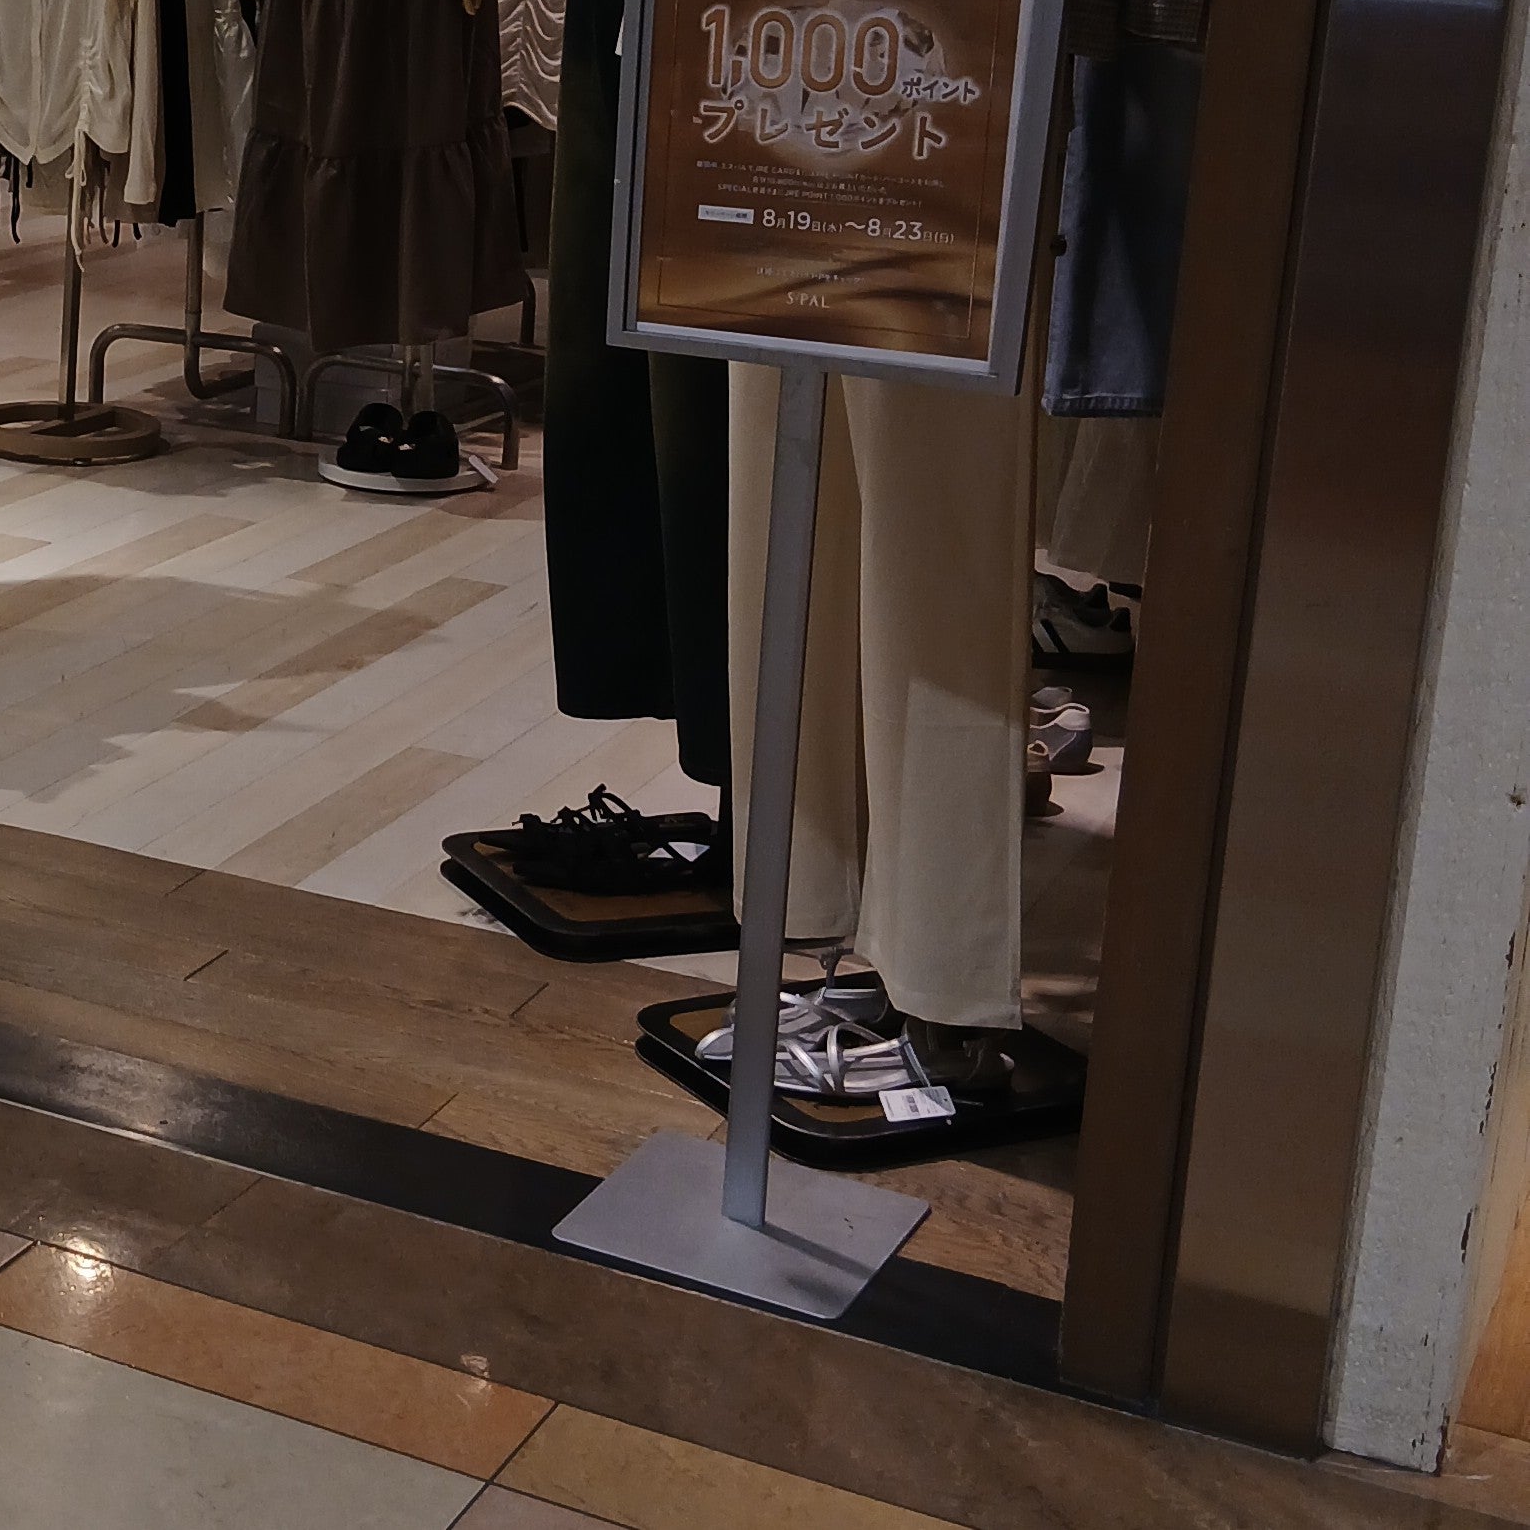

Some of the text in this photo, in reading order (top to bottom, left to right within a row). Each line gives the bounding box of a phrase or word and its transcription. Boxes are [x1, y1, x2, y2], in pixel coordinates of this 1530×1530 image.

[700, 99, 944, 158] プレゼント
